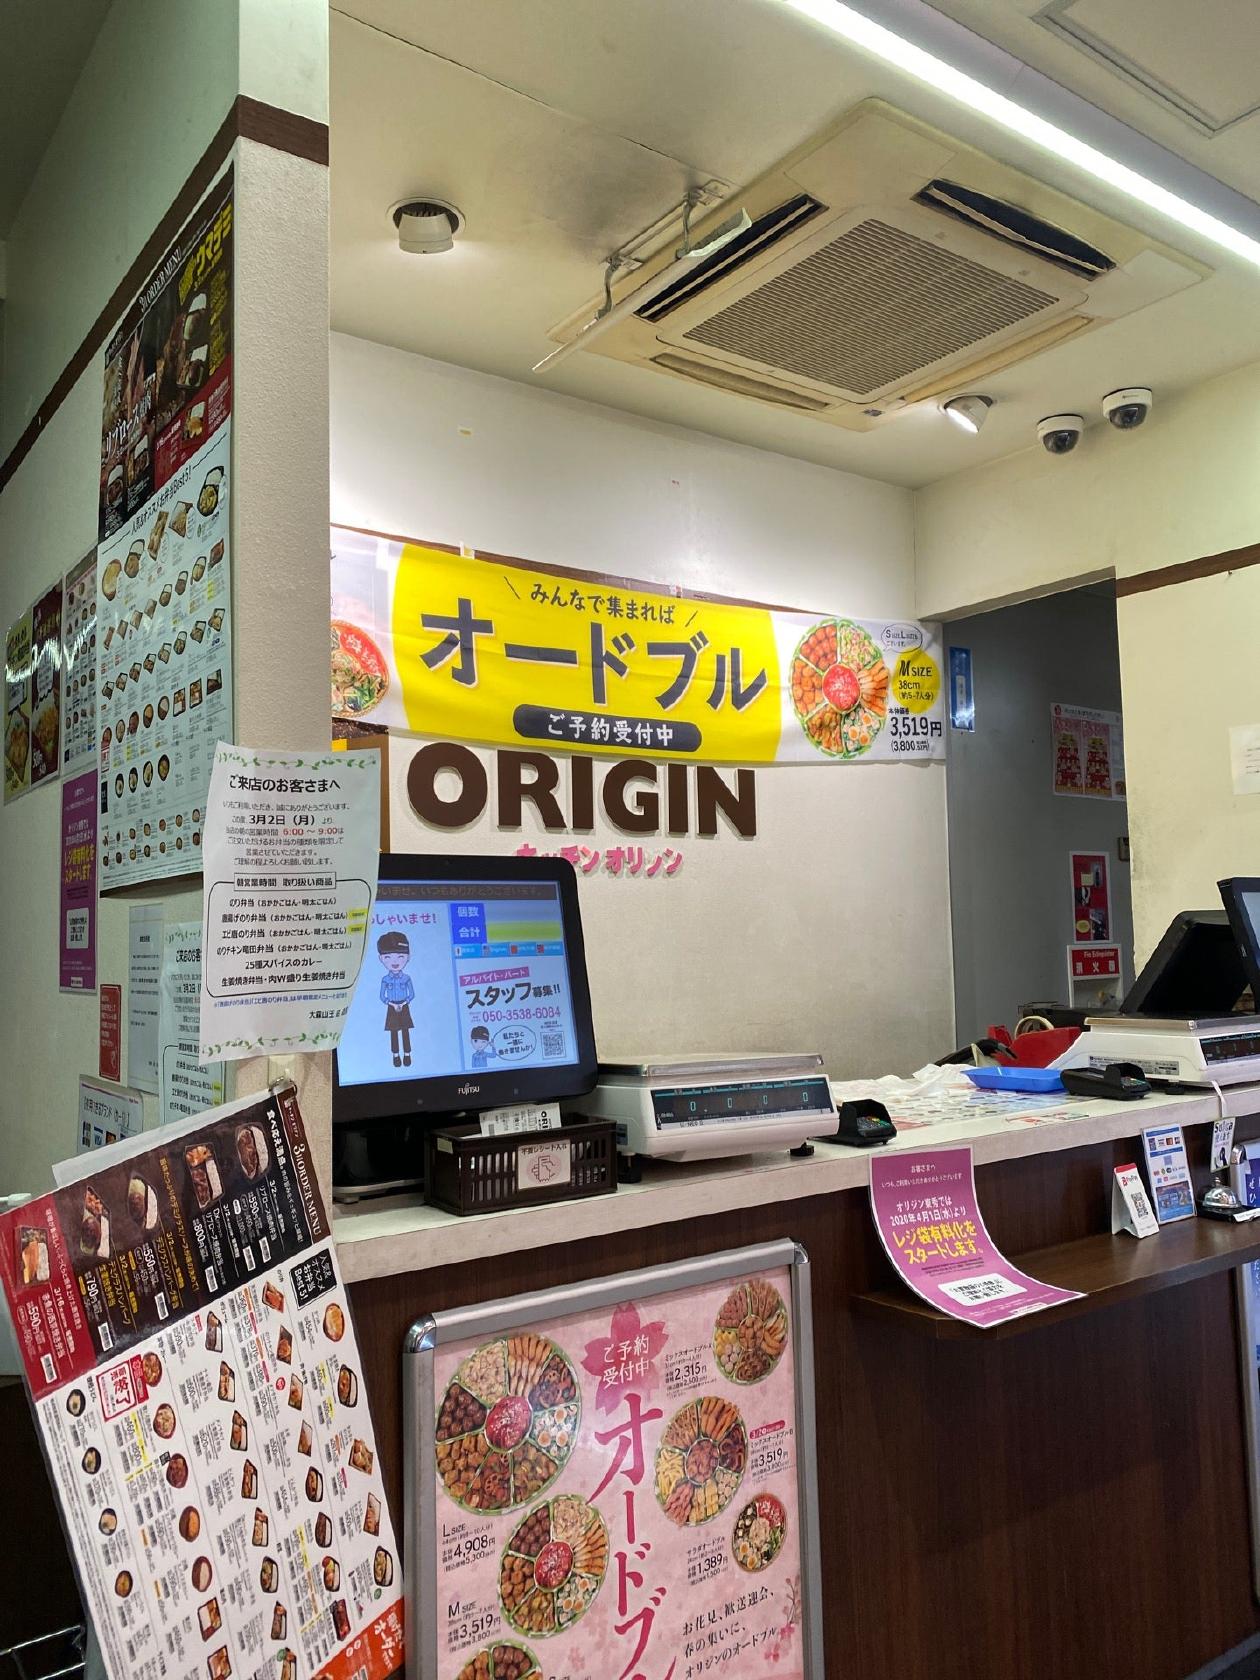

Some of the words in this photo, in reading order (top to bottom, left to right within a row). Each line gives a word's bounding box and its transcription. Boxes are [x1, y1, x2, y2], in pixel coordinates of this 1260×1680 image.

[531, 583, 675, 625] みんなで集まれば
[420, 597, 767, 714] オードブル
[912, 667, 932, 676] SIZE
[899, 680, 920, 689] 38cm
[547, 714, 675, 748] ご予約受付中
[891, 717, 942, 739] 3,519円
[230, 775, 341, 793] ご来店のお客さまへ
[406, 741, 757, 837] ORIGIN
[283, 878, 332, 886] 取り扱い商品
[457, 906, 479, 918] 個数
[458, 927, 480, 938] 合計
[245, 959, 322, 969] 25種スパイスのカレー
[463, 970, 526, 984] アルバイト・パート
[458, 1083, 480, 1096] FUJITSU
[892, 1221, 977, 1248] レジ袋有料化を
[302, 1263, 315, 1292] お弁当
[311, 1258, 324, 1291] オススメ
[604, 1334, 649, 1362] ご予約
[603, 1358, 649, 1390] 受付中
[443, 1524, 450, 1537] L
[451, 1523, 466, 1535] SIZE
[586, 1394, 677, 1680] オードブ
[454, 1534, 496, 1558] 4,908円
[448, 1601, 460, 1618] M
[462, 1601, 476, 1614] SIZE
[683, 1586, 774, 1636] お花見、歓送迎会、
[460, 1614, 500, 1639] 3,519円
[686, 1627, 777, 1679] オリジンのオードブル
